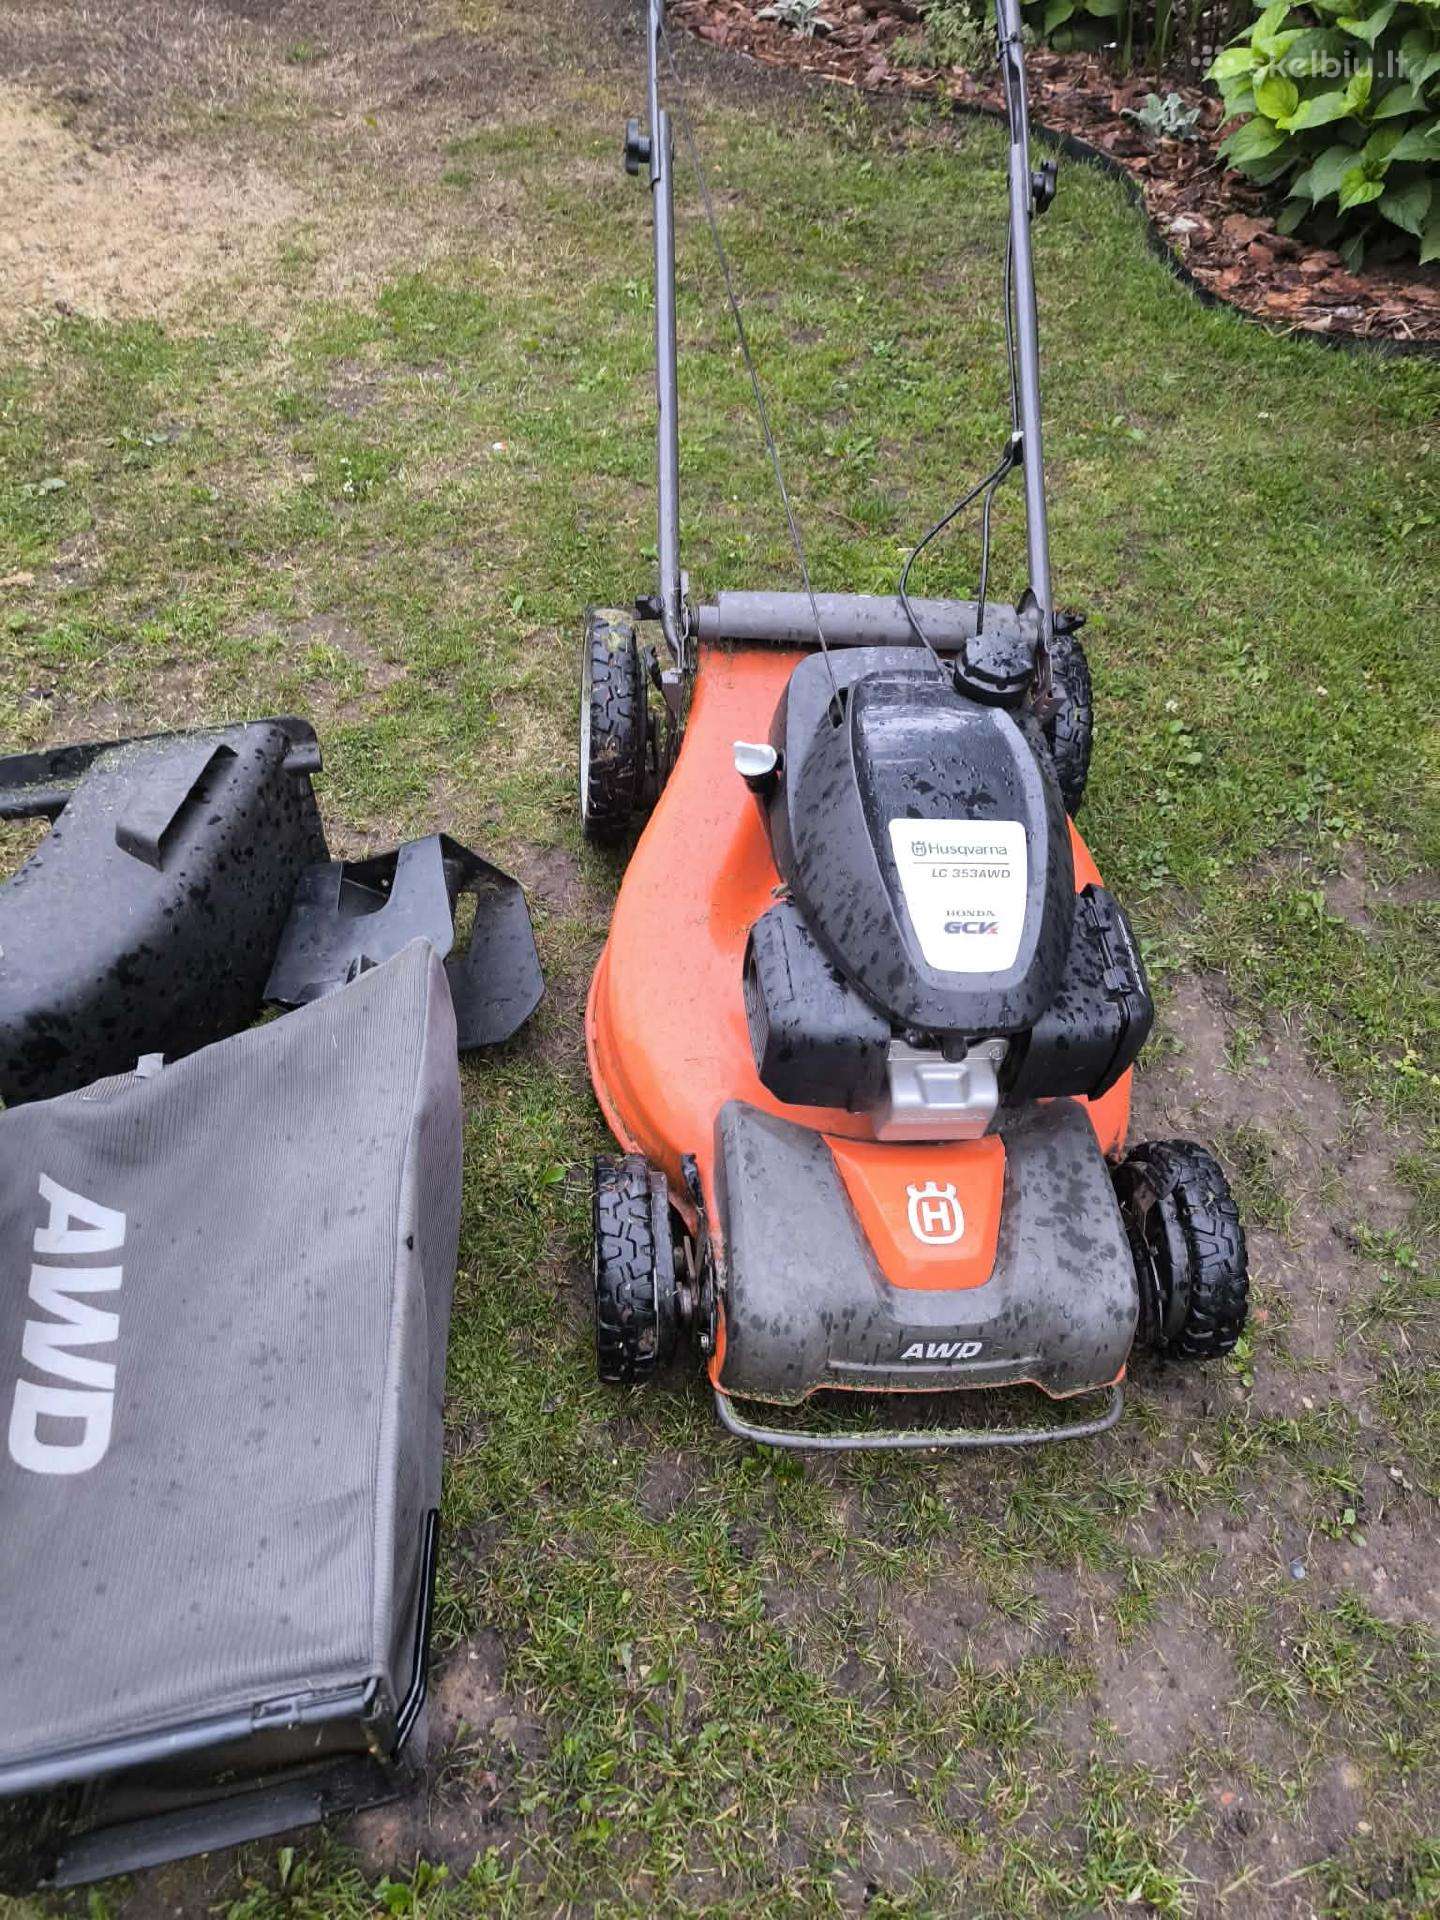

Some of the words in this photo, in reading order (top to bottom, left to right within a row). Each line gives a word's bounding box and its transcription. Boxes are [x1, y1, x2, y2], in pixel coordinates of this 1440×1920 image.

[928, 842, 1008, 855] Husqvarna
[932, 868, 948, 878] LC
[951, 868, 1011, 878] 353AWD
[8, 1172, 126, 1475] AWD
[901, 1341, 983, 1359] AWD
